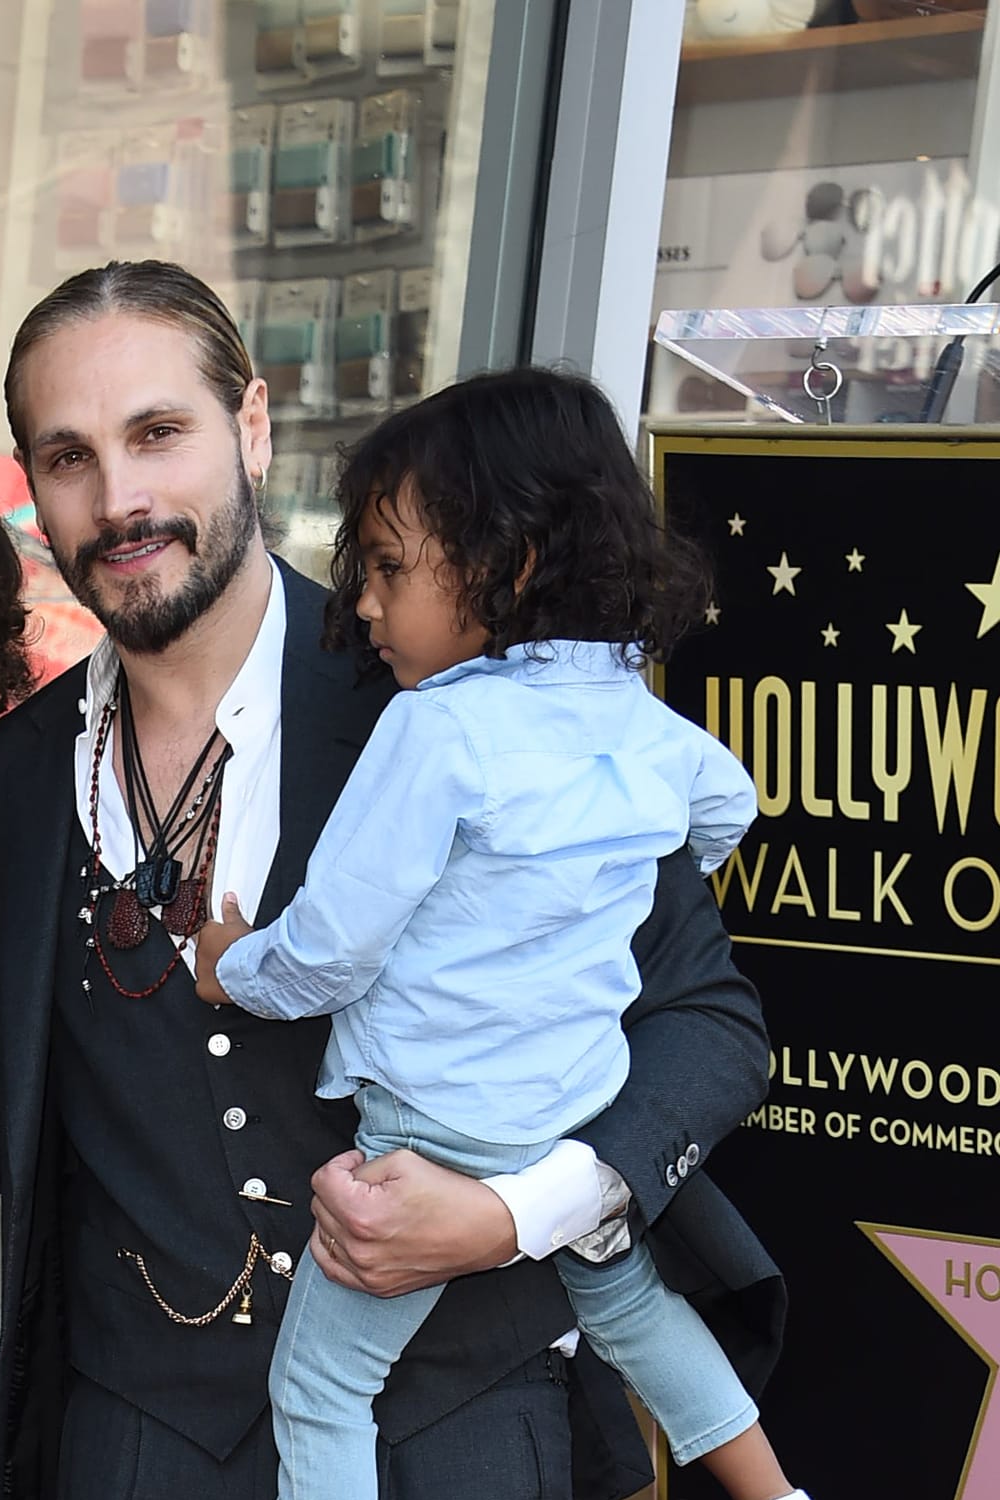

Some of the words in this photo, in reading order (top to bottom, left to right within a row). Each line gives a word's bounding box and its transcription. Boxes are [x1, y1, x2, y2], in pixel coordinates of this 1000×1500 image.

[706, 675, 1000, 836] HOLLYW
[711, 843, 914, 926] WALK
[768, 1046, 1000, 1107] LLYWOOD
[740, 1104, 816, 1135] MBER
[825, 1111, 861, 1139] OF
